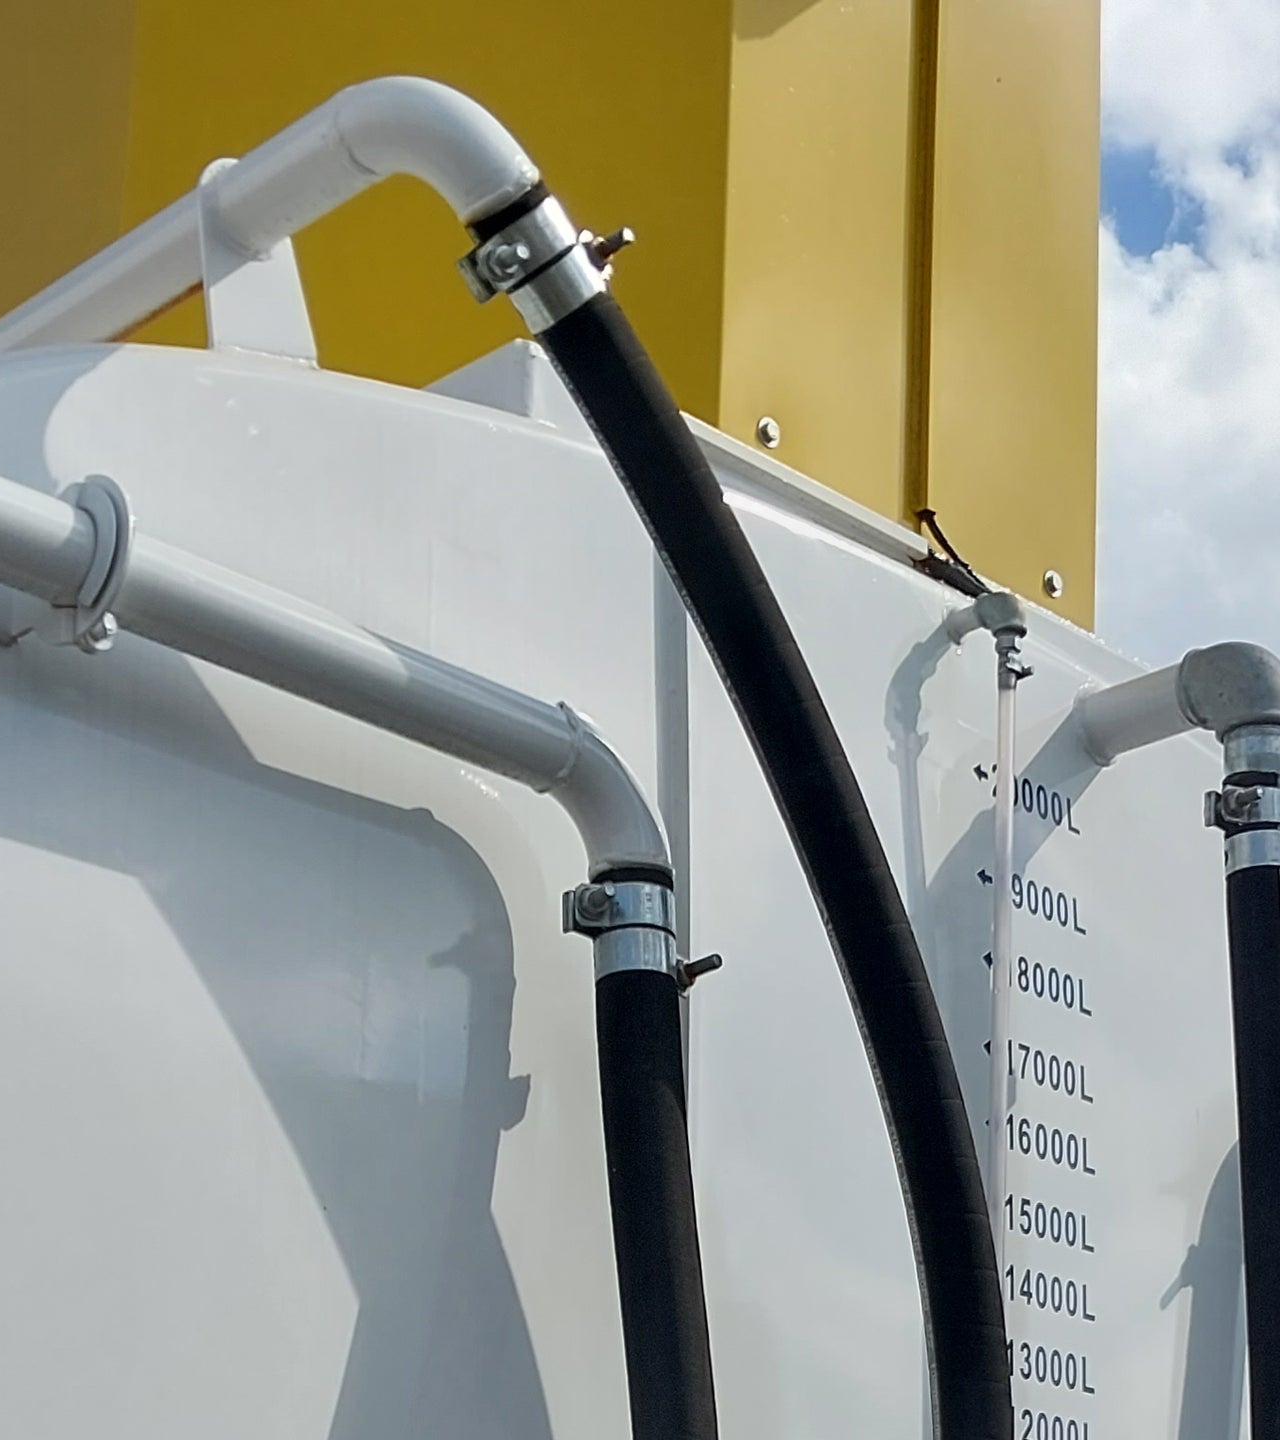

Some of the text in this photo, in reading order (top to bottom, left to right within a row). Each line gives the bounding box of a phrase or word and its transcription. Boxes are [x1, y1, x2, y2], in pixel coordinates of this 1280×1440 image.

[1009, 955, 1092, 1017] 8000L
[1007, 1039, 1093, 1104] 17000L
[1005, 1114, 1096, 1176] 16000L
[1004, 1193, 1095, 1253] 15000L
[1005, 1264, 1096, 1322] 14000L
[1006, 1338, 1096, 1395] 13000L
